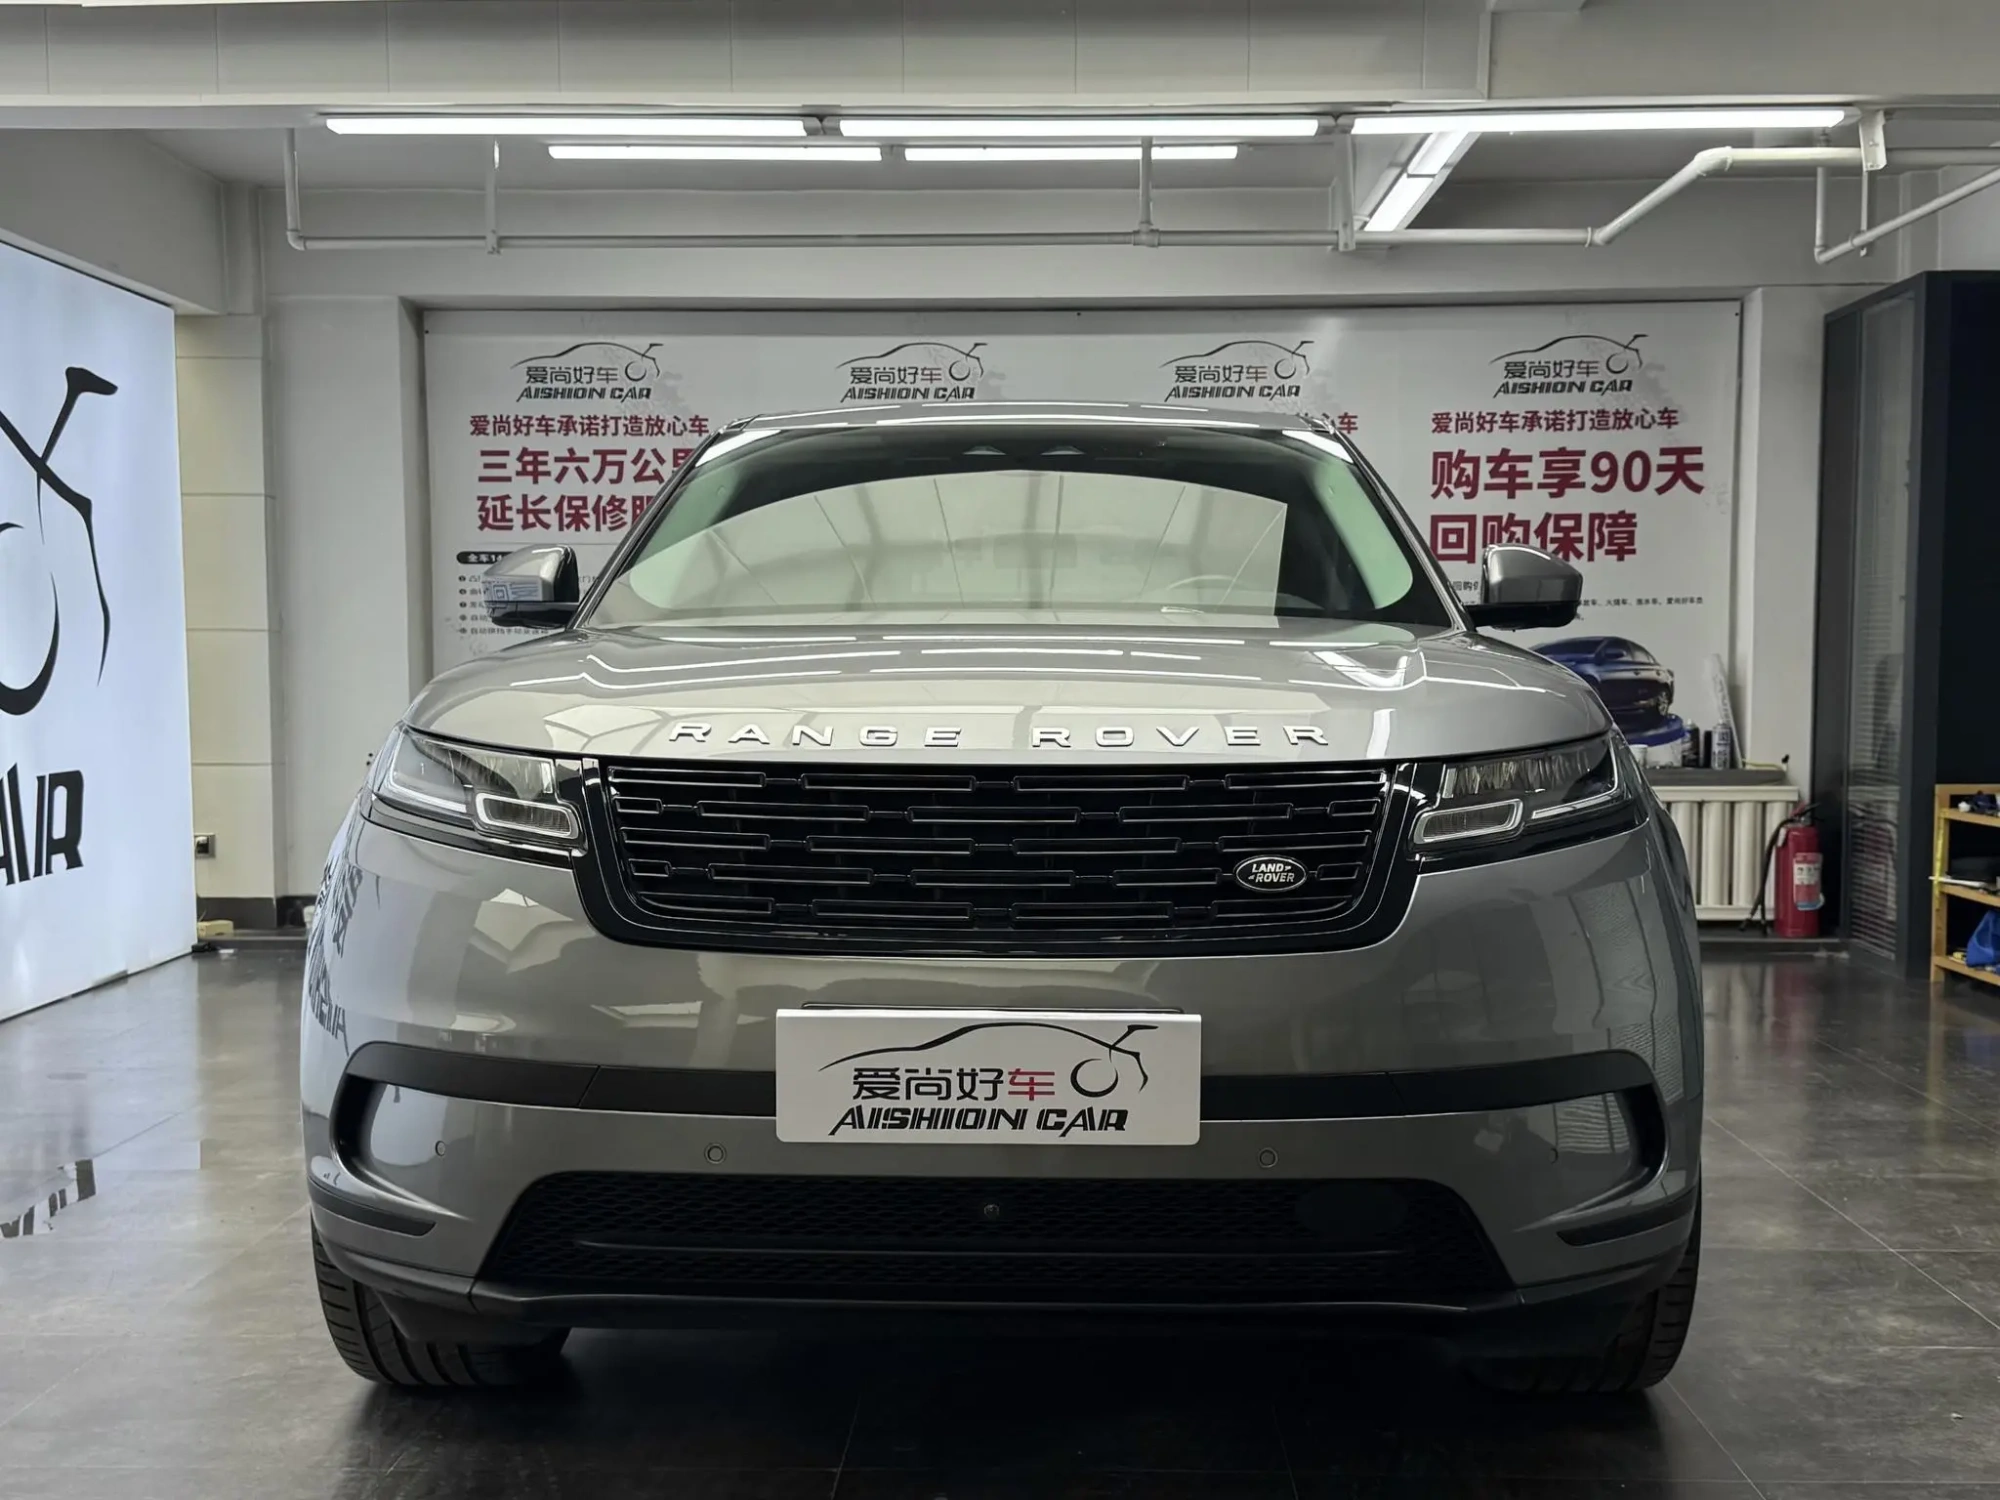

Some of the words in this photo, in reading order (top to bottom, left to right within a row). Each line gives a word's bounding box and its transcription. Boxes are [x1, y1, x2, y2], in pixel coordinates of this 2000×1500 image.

[526, 366, 618, 384] 爱尚好车
[850, 366, 942, 384] 爱尚好车
[1174, 364, 1268, 383] 爱尚好车
[1503, 359, 1600, 379] 爱尚好车
[609, 386, 651, 403] CAR
[933, 386, 975, 402] CAR
[1258, 384, 1300, 402] CAR
[1589, 379, 1633, 396] CAR
[470, 415, 709, 437] 爱尚好车承诺打造放心车
[1431, 407, 1679, 434] 爱尚好车承诺打造放心车
[1431, 446, 1704, 499] 购车享90天
[668, 722, 963, 747] RANGE
[1029, 725, 1330, 749] ROVER
[1252, 863, 1284, 872] LAND
[1255, 873, 1294, 882] ROVER
[852, 1067, 1056, 1101] 爱尚好车
[828, 1104, 1028, 1136] AISHION
[1036, 1107, 1129, 1138] CAR
